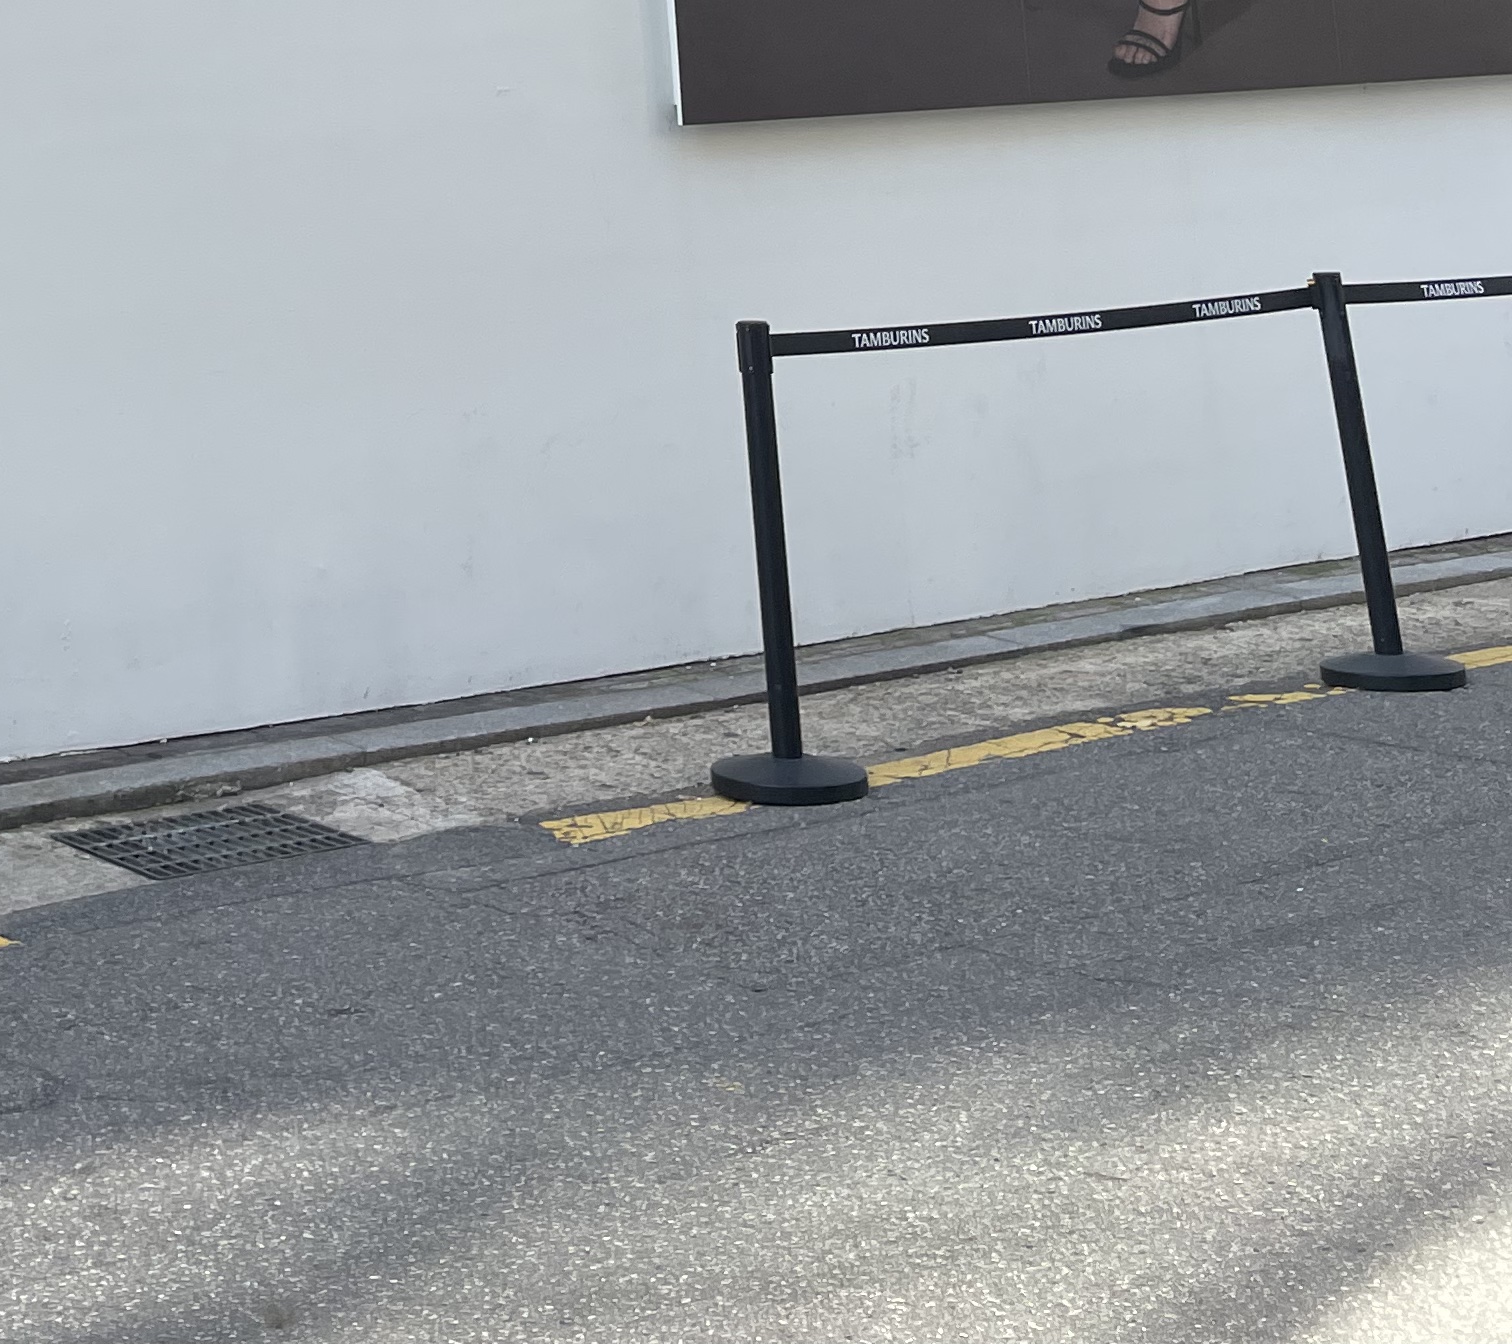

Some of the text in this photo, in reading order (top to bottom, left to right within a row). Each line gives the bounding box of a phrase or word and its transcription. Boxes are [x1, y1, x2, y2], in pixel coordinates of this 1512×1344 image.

[1420, 280, 1485, 299] TAMBURINS
[1192, 296, 1262, 318] TAMBURINS
[1028, 314, 1103, 336] TAMBURINS
[851, 328, 930, 349] TAMBURINS
